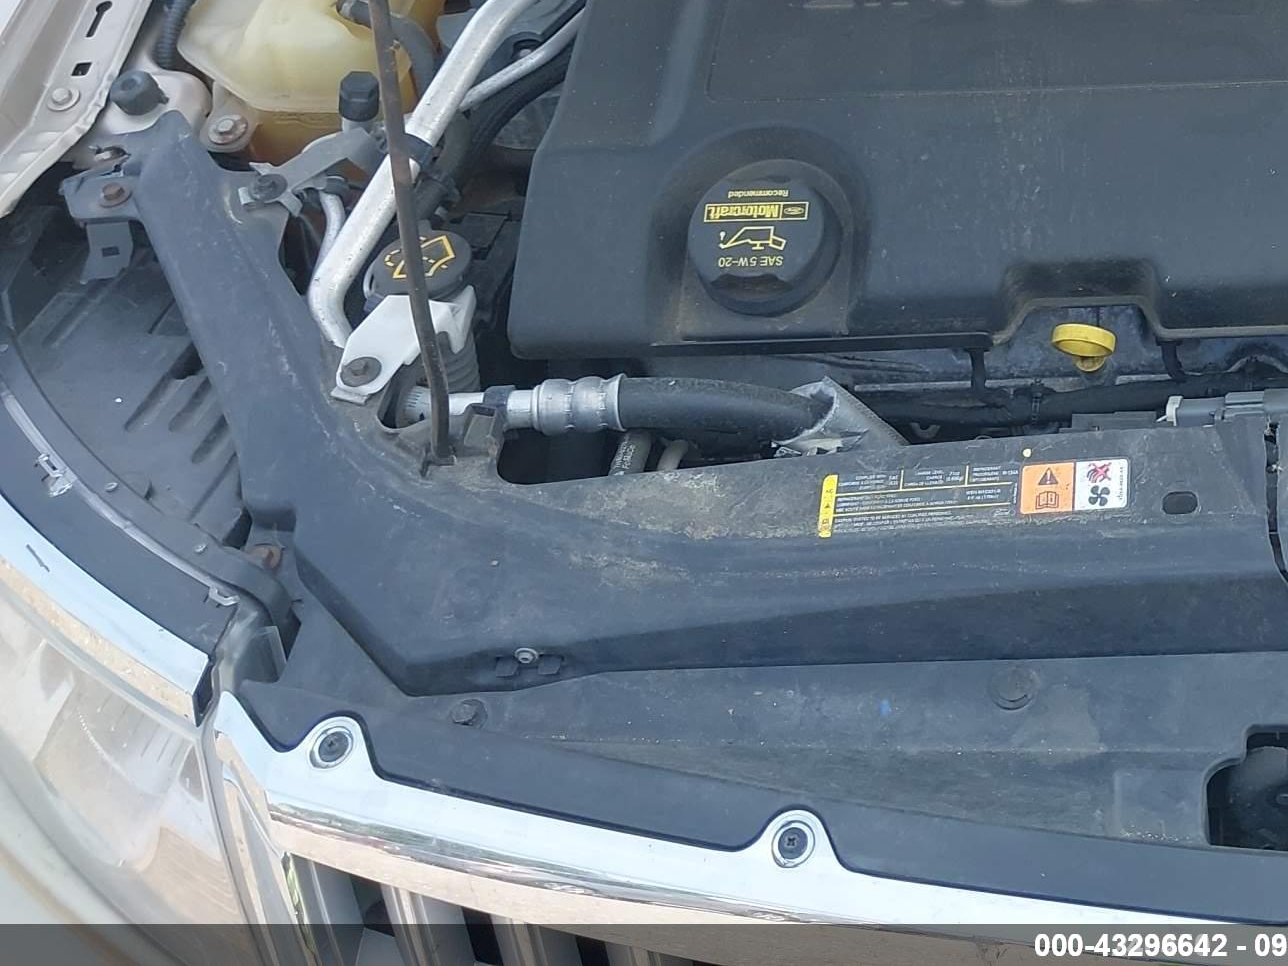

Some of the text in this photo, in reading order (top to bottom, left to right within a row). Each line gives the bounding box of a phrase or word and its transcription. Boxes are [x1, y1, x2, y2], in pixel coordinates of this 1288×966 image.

[727, 189, 789, 199] Recommended
[708, 204, 780, 219] Motorcraft
[718, 255, 784, 268] SAE 5W-20
